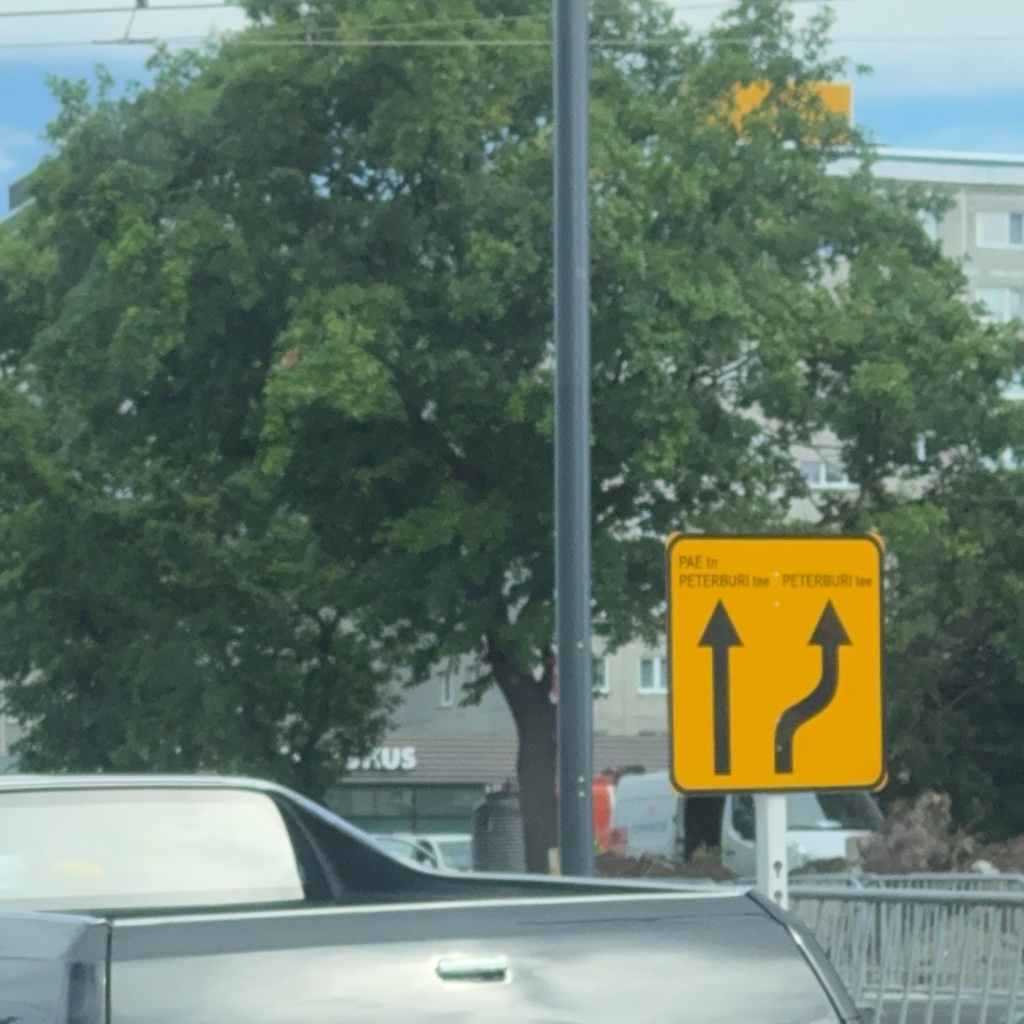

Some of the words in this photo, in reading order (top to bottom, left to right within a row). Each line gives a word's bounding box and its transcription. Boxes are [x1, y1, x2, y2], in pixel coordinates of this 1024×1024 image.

[679, 555, 703, 568] PAE
[679, 574, 750, 587] PETERBURI
[752, 576, 770, 587] tee
[782, 574, 852, 587] PETERBURI
